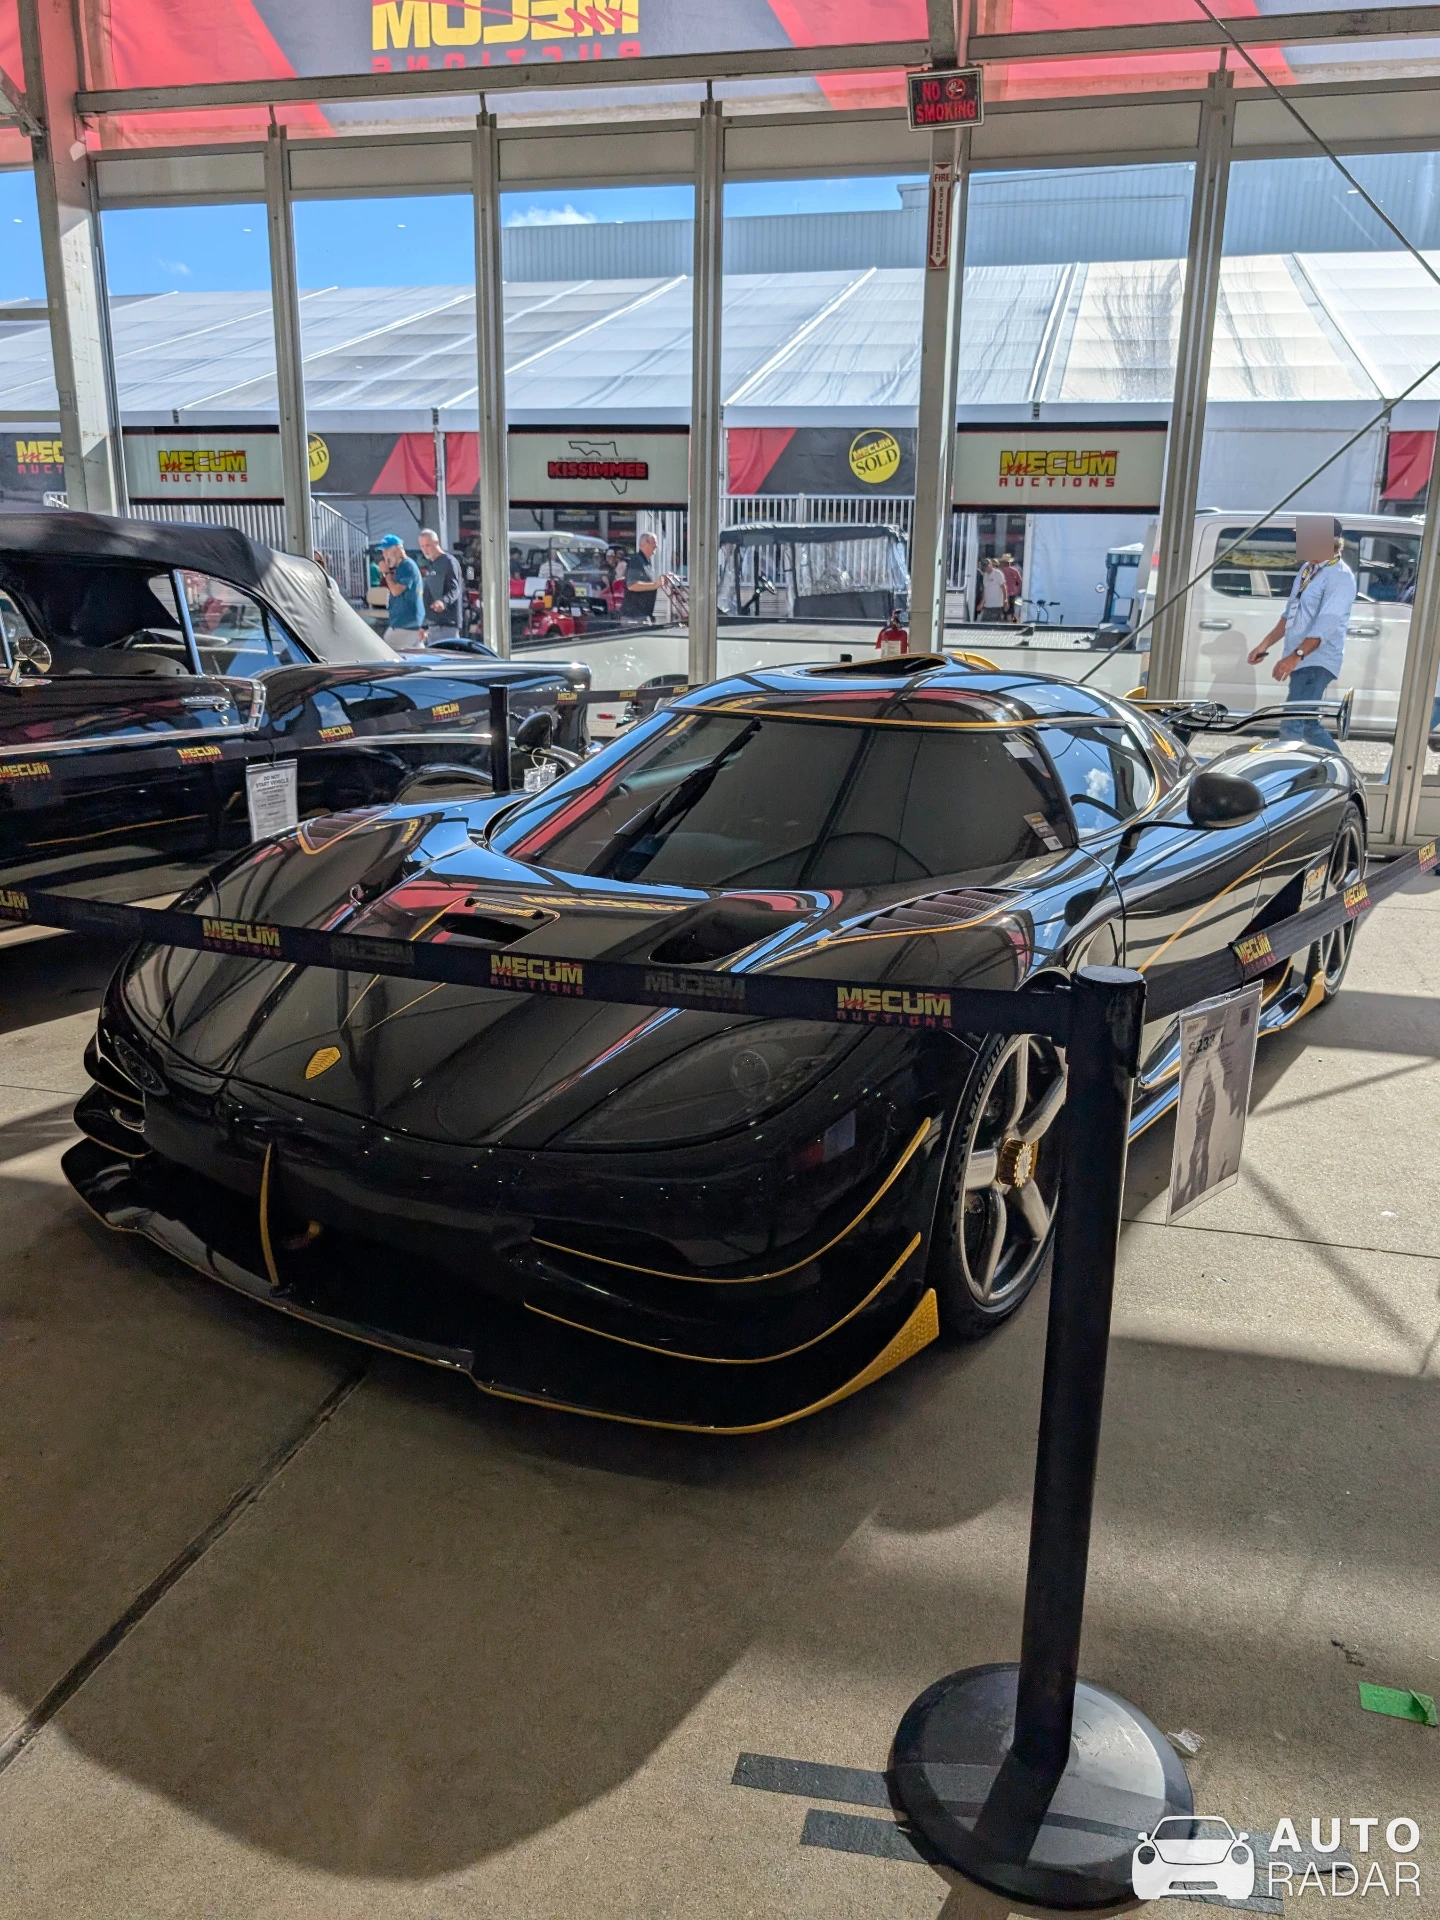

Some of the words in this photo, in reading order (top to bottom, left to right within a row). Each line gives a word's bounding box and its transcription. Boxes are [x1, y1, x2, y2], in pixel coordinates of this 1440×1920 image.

[921, 80, 941, 100] NO
[915, 100, 976, 123] SMOKING
[934, 173, 950, 183] FIRE
[936, 186, 944, 258] EXTINGUISHER
[16, 440, 64, 463] MEC
[310, 449, 327, 467] LD
[852, 437, 893, 461] MECUM
[17, 464, 63, 474] AUCT
[158, 450, 248, 474] MECUM
[548, 461, 648, 480] KISSIMMEE
[856, 448, 897, 475] SOLD
[1000, 450, 1117, 476] MECUM
[160, 474, 248, 483] AUCTIONS
[999, 477, 1115, 487] AUCTIONS
[432, 703, 460, 716] MECUM
[318, 725, 354, 738] MECUM
[177, 745, 221, 758] MECUM
[202, 919, 280, 947] MECUM
[1232, 933, 1272, 964] MECUM
[490, 955, 583, 983] MECUM
[490, 975, 585, 996] AUCTIONS
[837, 987, 951, 1016] MECUM
[837, 1010, 953, 1029] AUCTIONS
[969, 1035, 1005, 1119] MICHELIN
